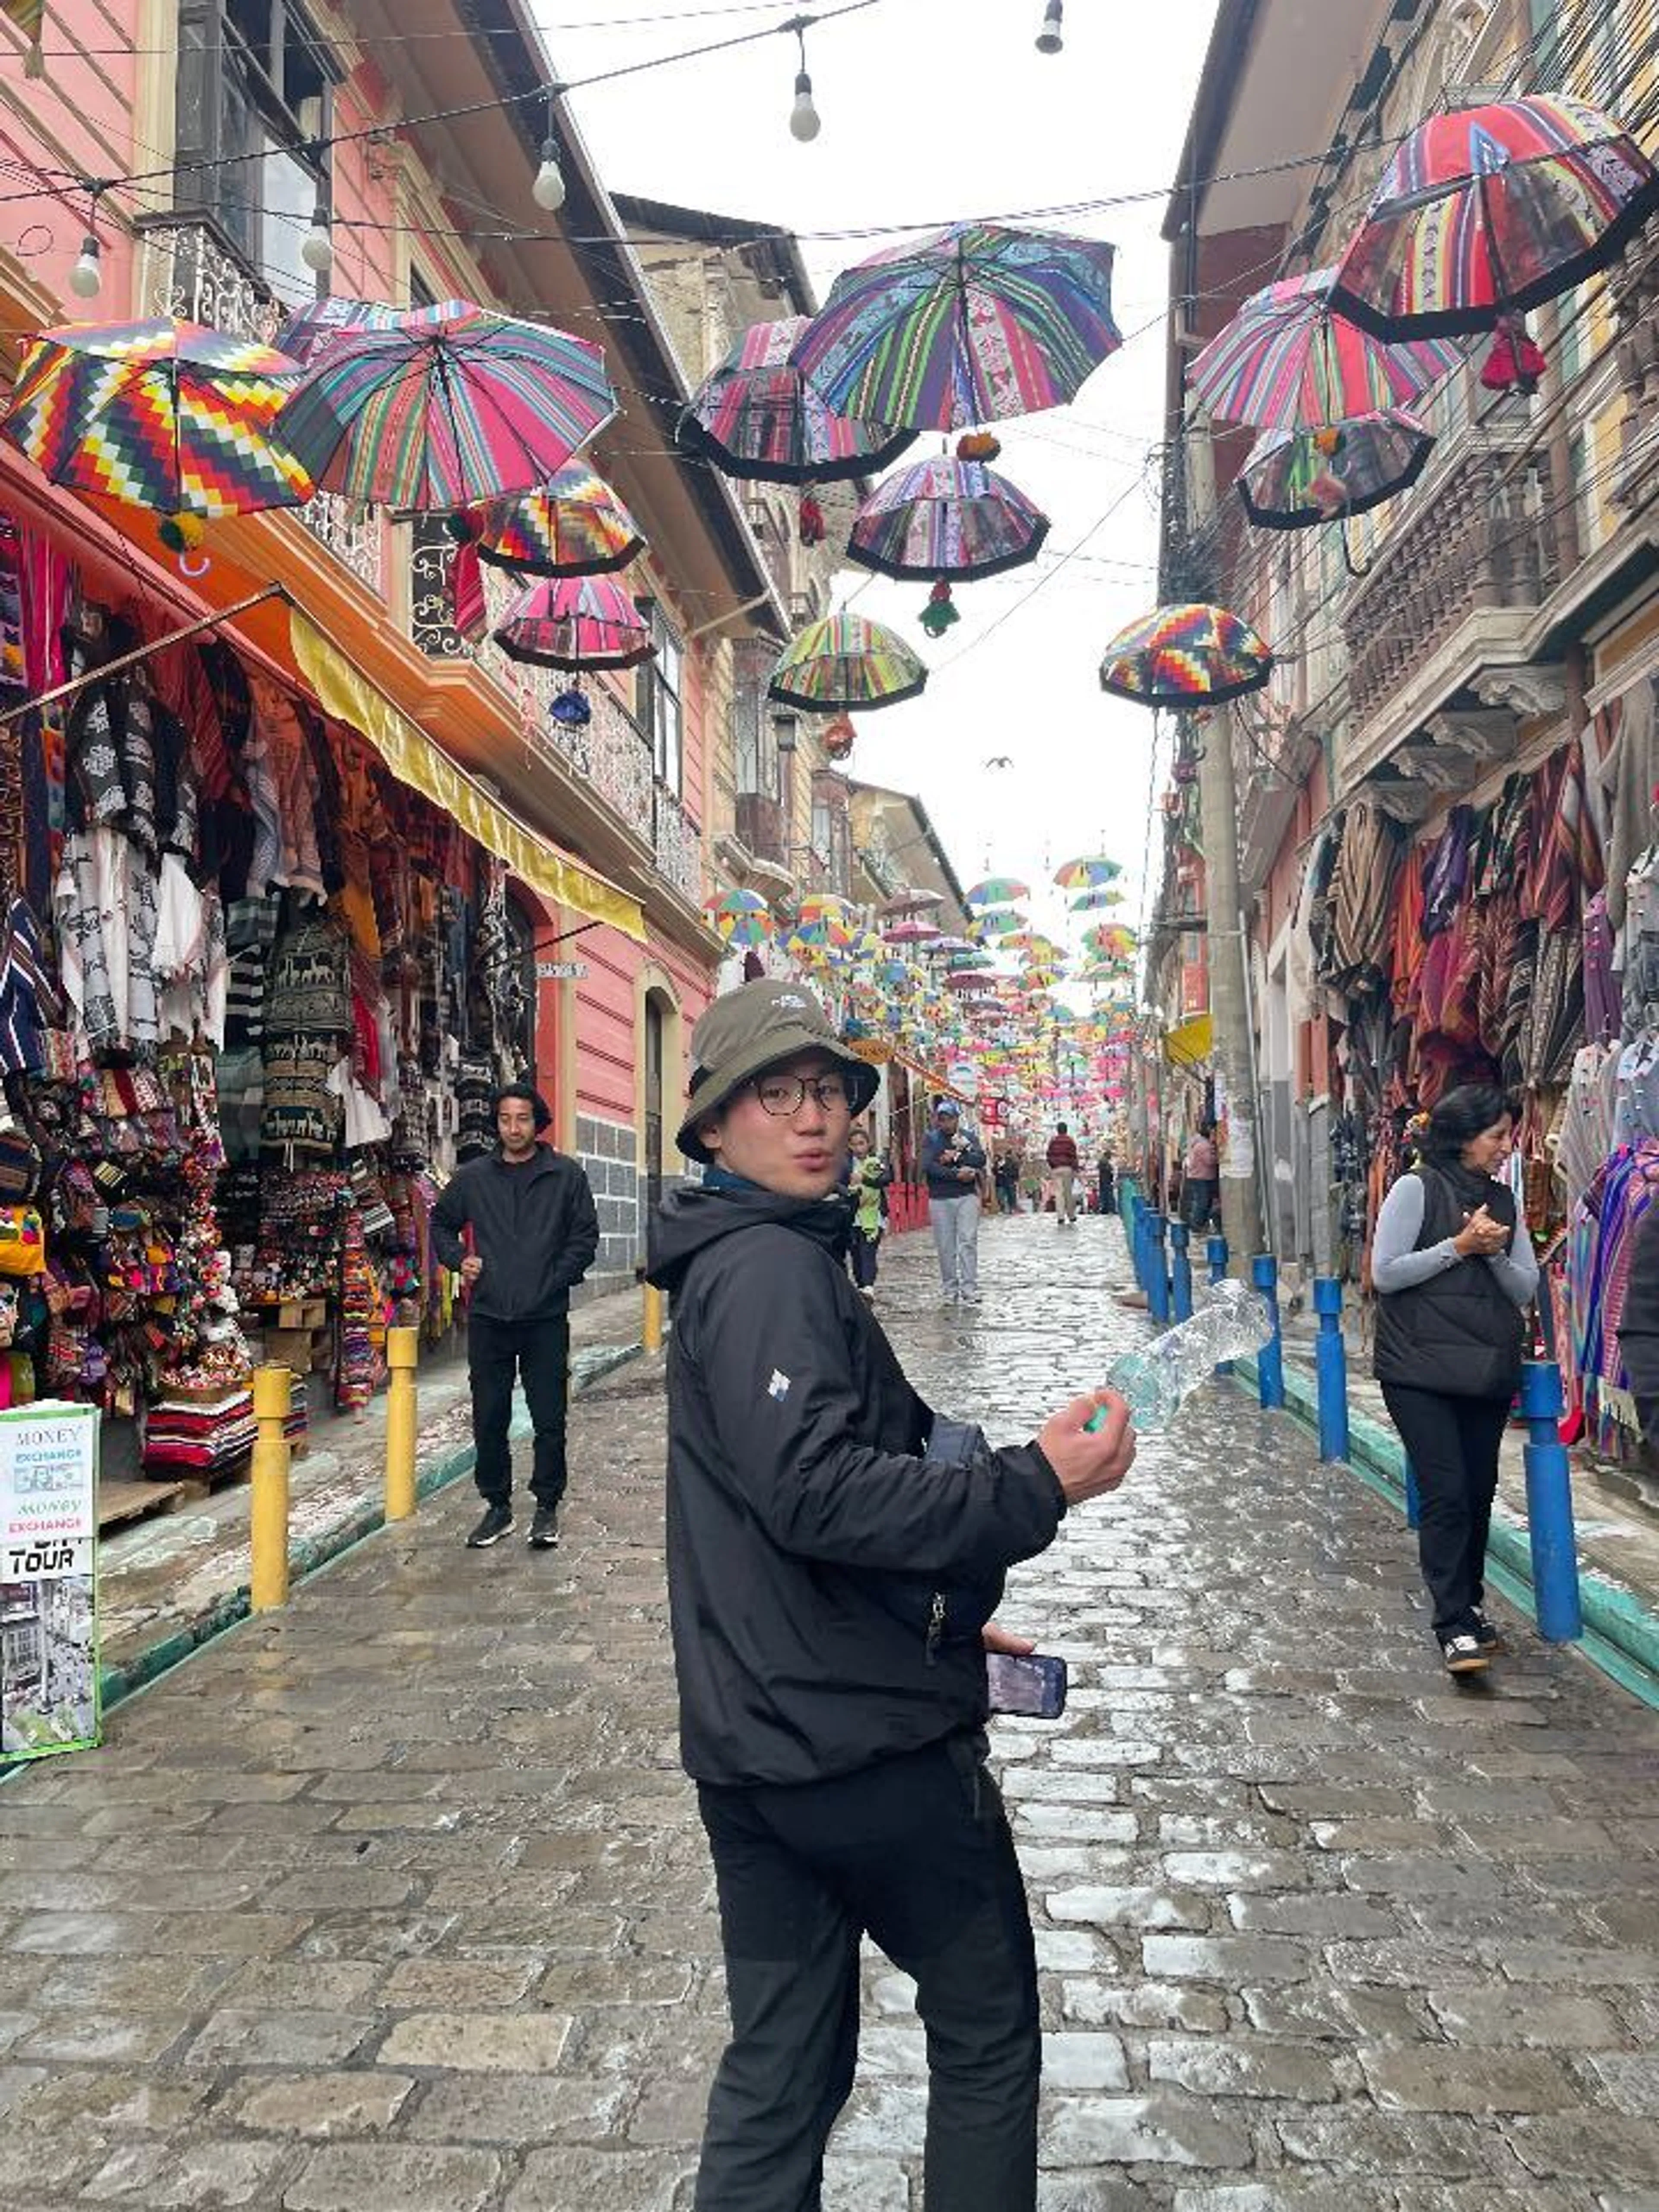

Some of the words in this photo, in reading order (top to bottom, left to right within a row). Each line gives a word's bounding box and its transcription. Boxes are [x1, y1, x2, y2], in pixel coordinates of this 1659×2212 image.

[16, 1426, 83, 1446] MONEY
[16, 1449, 82, 1463] EXCHANGE
[9, 1517, 81, 1533] EXCHANGE
[9, 1548, 75, 1574] TOUR
